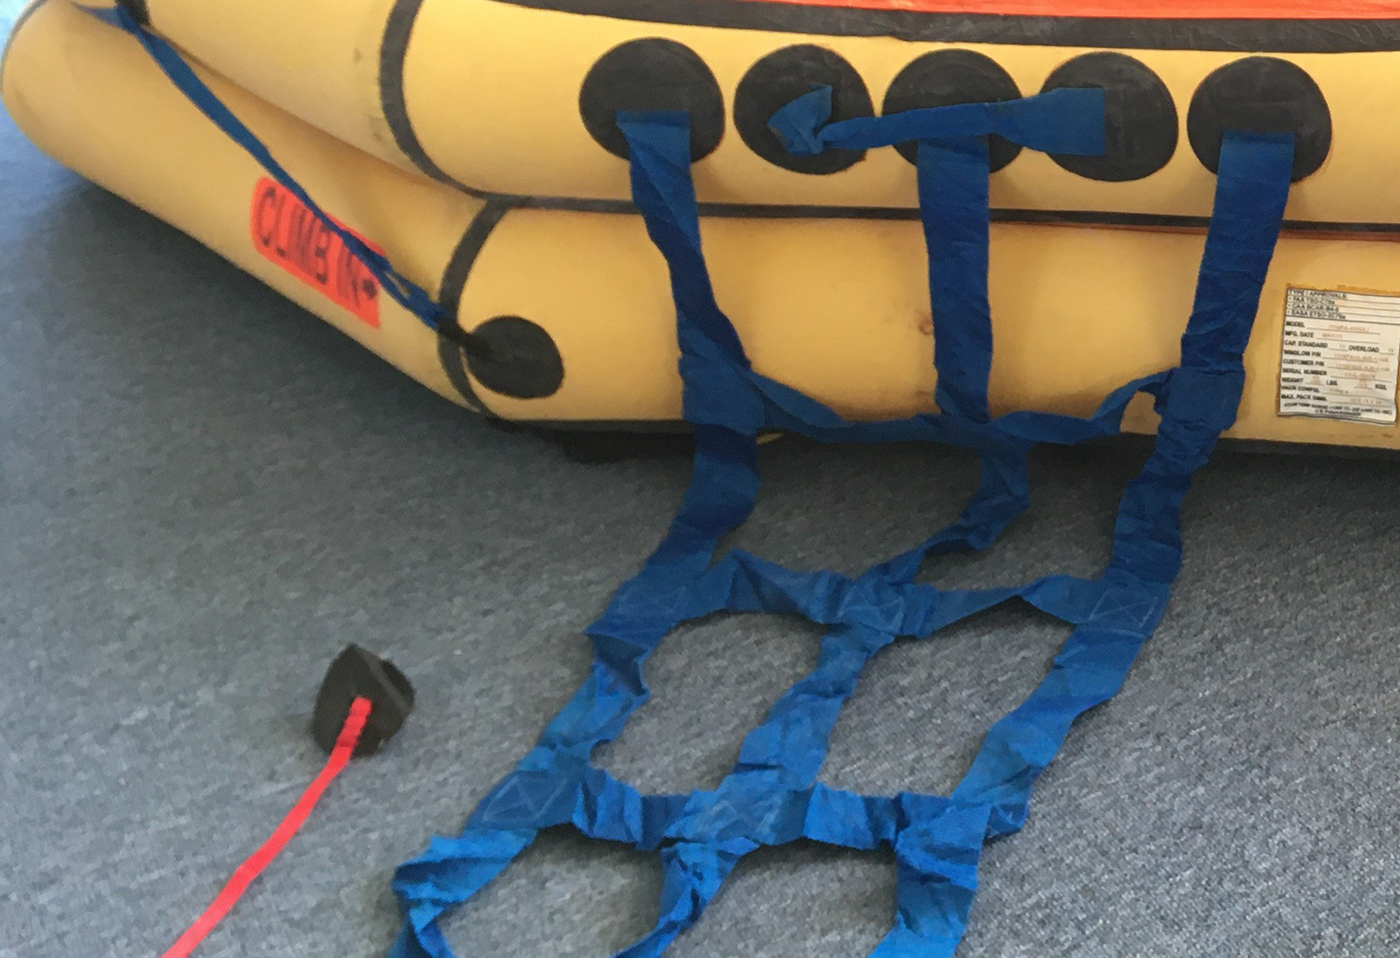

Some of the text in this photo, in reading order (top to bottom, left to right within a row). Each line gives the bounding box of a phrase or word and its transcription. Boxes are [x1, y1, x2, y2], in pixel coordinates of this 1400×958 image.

[255, 184, 329, 285] CLIMB
[1297, 340, 1328, 348] STANDARD
[1348, 345, 1380, 353] OVERLOAD
